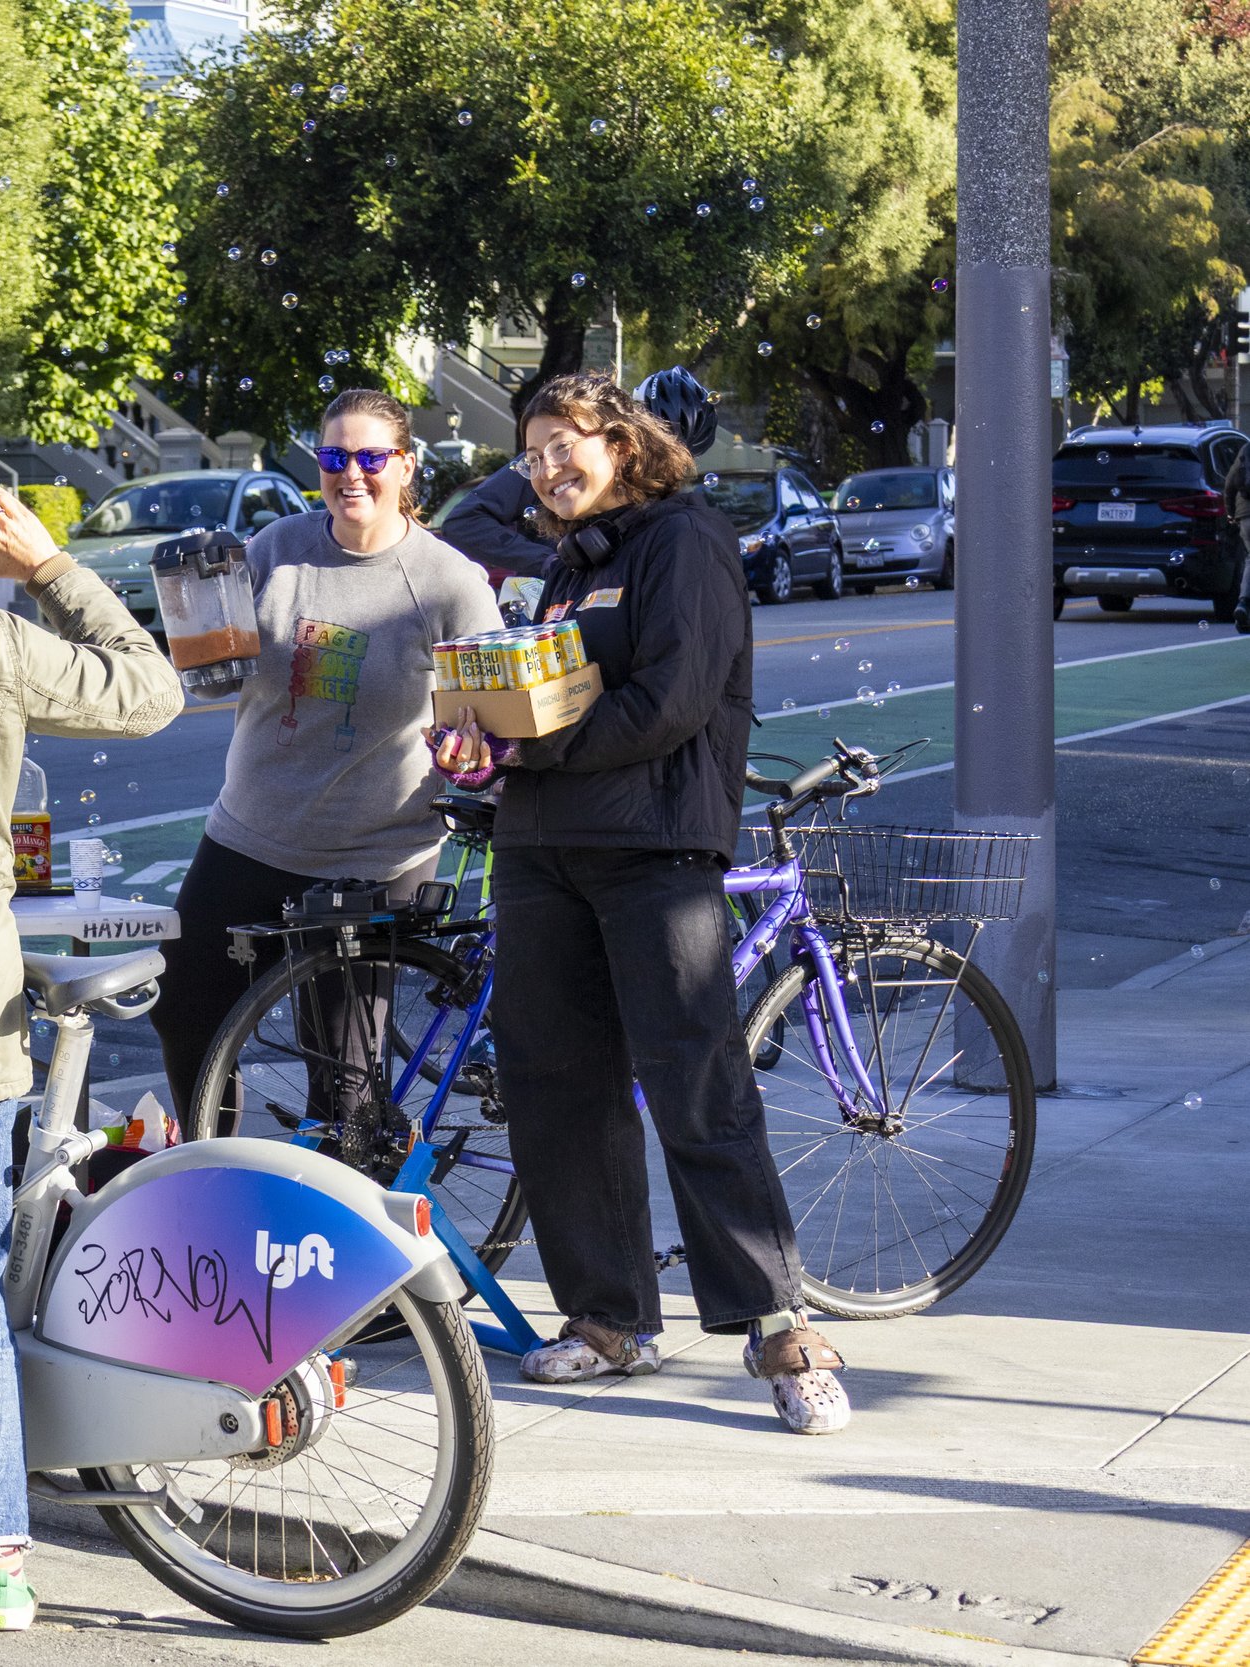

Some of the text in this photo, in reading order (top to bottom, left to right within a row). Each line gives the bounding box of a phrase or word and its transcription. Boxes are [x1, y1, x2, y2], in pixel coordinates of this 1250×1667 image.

[304, 625, 357, 649] PAGE
[537, 680, 591, 709] MACHU PICCHU
[83, 919, 167, 938] HAYDEN
[9, 1212, 34, 1284] 861-3481
